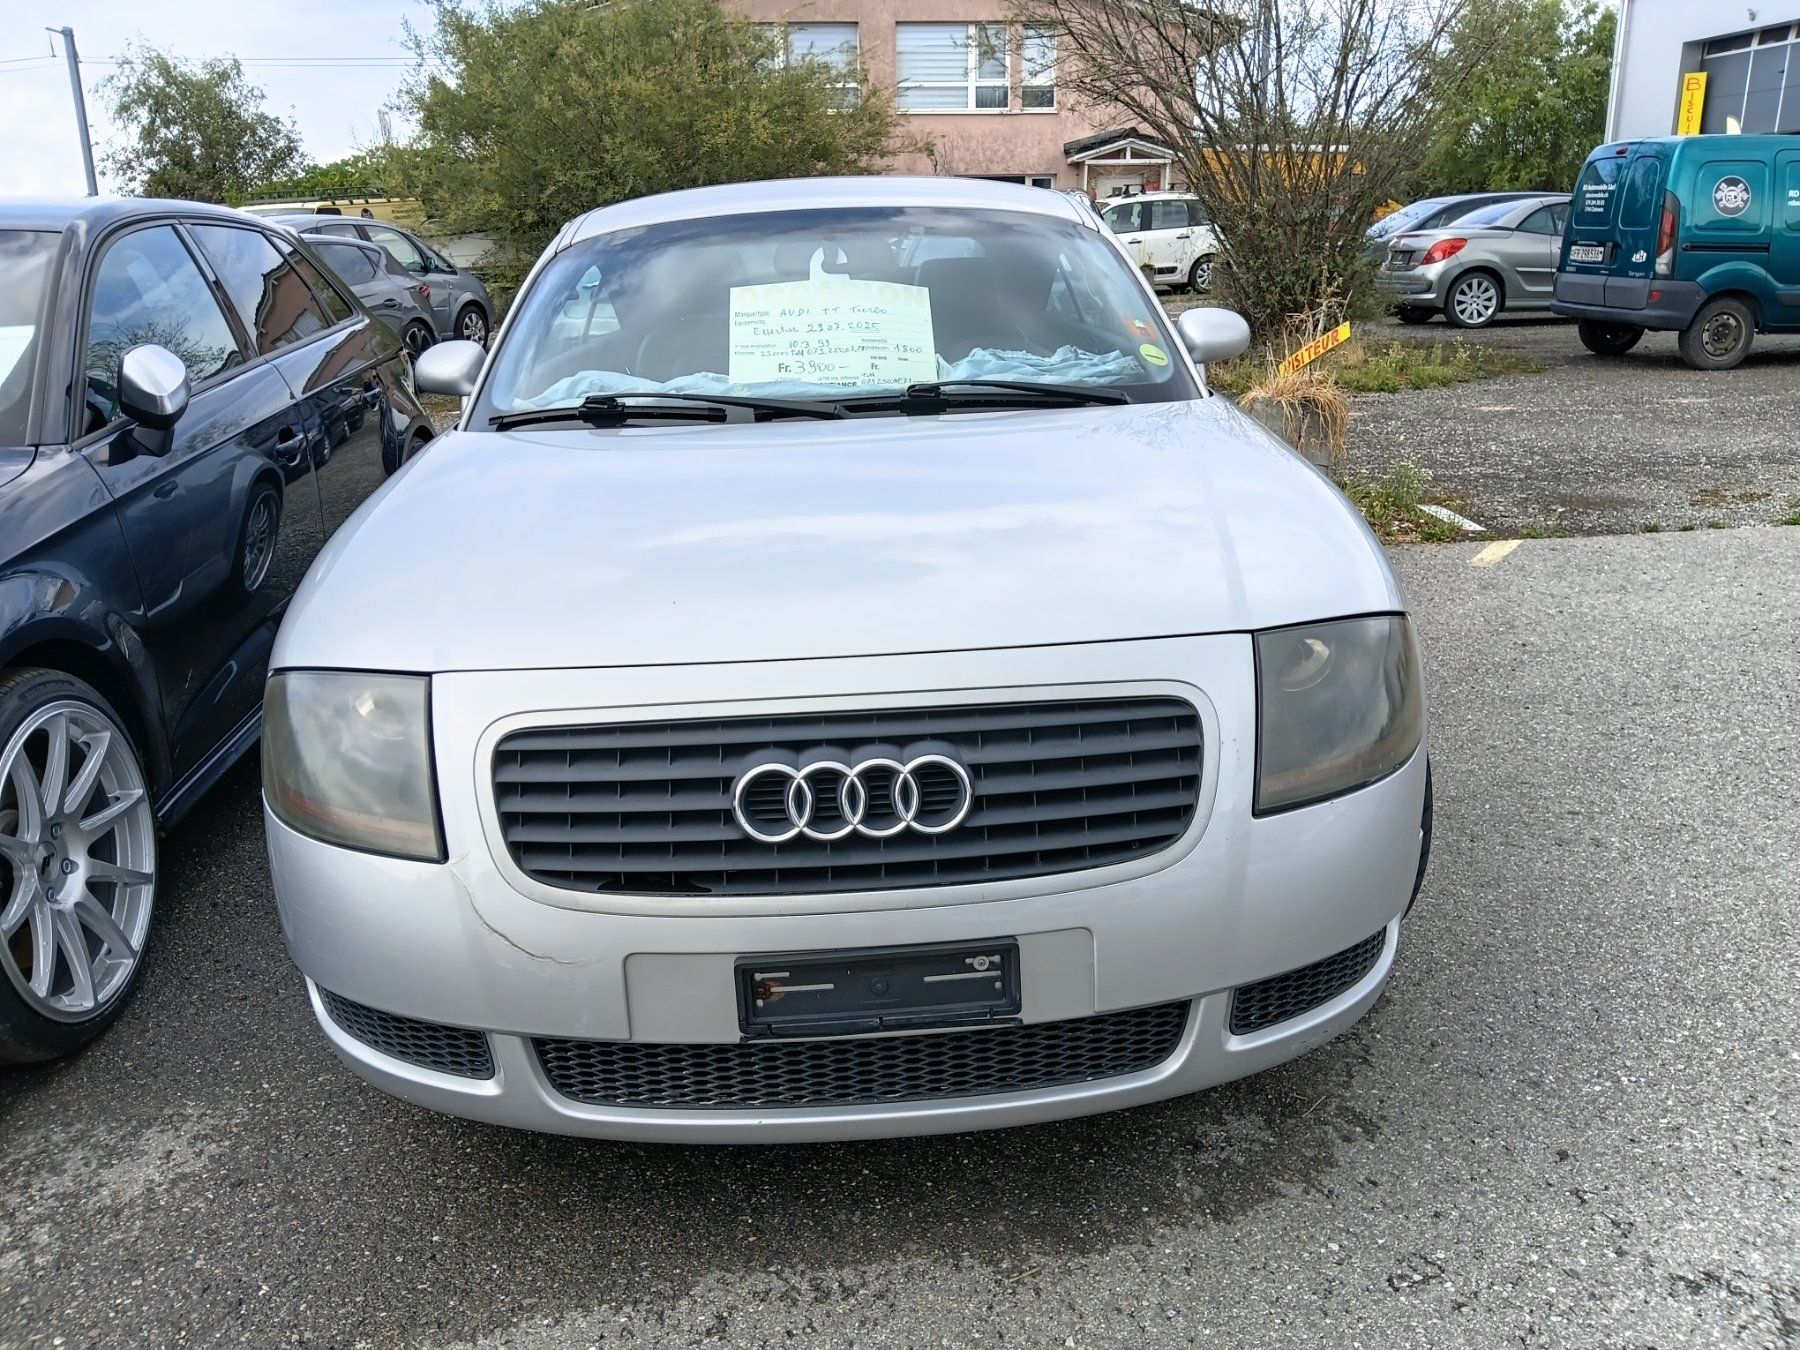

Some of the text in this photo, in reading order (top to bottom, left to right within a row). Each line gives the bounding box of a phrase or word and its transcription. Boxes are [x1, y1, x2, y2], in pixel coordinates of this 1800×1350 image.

[780, 308, 810, 317] AUDI
[822, 306, 839, 315] TT
[778, 363, 791, 373] Fr.
